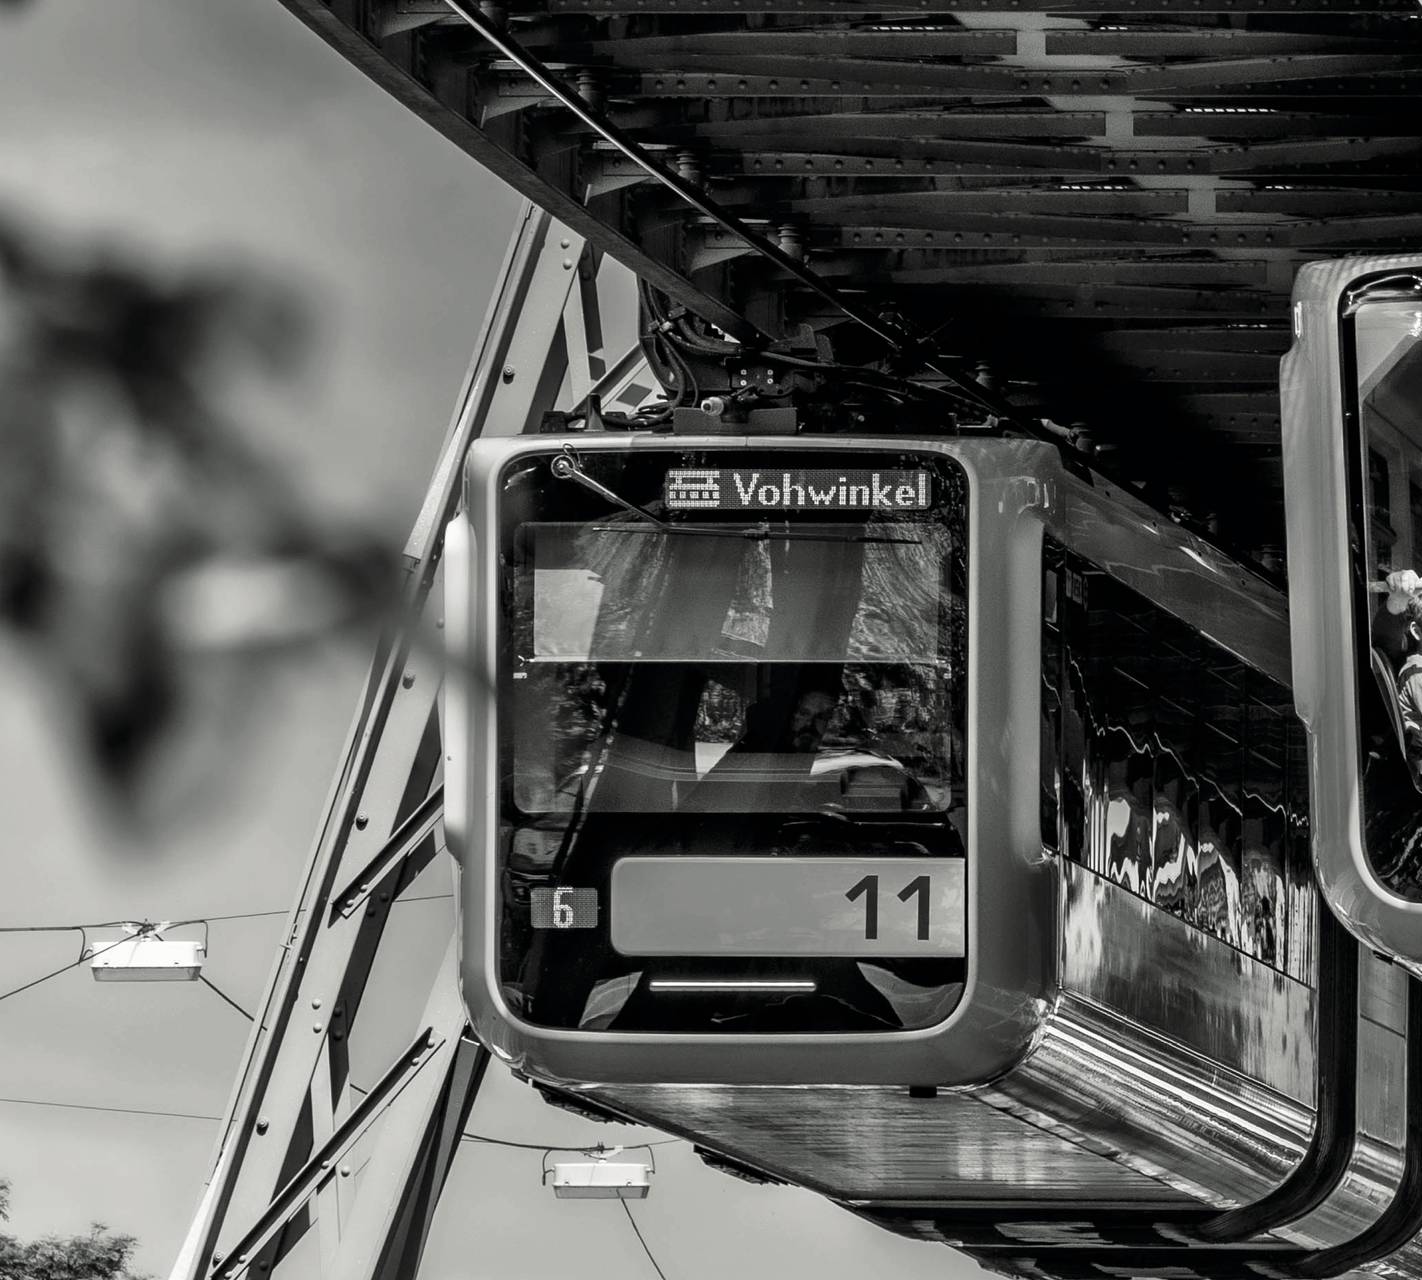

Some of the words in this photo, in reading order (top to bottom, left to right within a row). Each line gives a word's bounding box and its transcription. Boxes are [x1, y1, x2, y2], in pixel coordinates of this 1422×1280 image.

[733, 473, 926, 506] Vohwinkel
[554, 886, 573, 928] 6
[844, 875, 930, 940] 11
